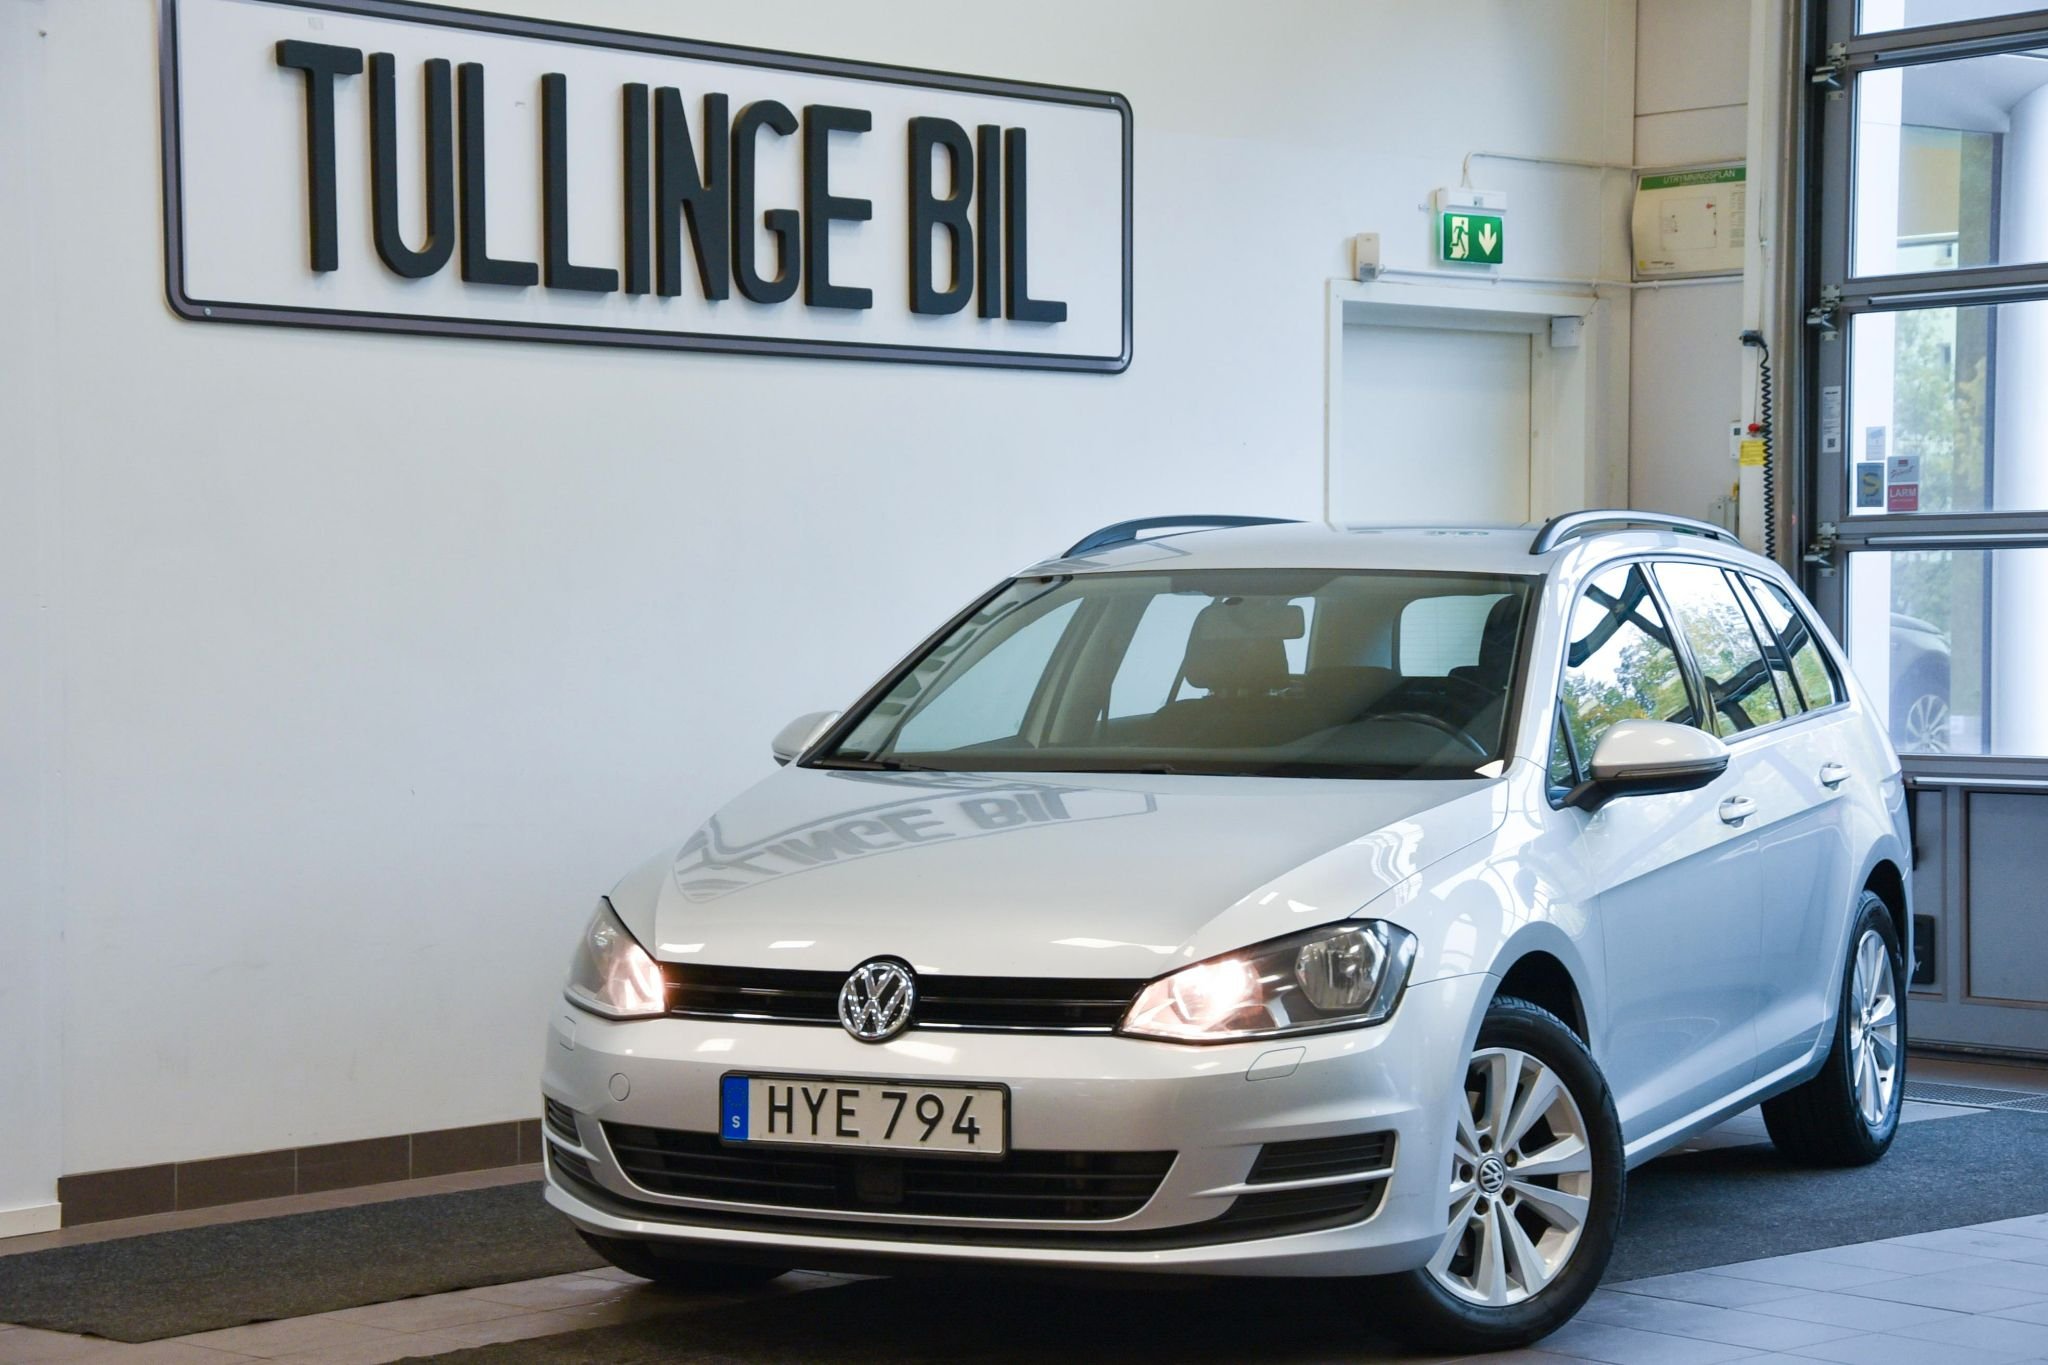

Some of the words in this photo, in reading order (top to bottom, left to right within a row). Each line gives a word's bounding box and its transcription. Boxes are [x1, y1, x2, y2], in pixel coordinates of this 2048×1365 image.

[275, 39, 874, 311] TULLINGE
[909, 116, 1067, 324] BIL
[1663, 169, 1736, 185] UTRYMNINGSPLAN
[1889, 487, 1917, 498] LARM
[840, 962, 914, 1041] VW
[731, 1114, 741, 1129] S
[768, 1085, 860, 1138] HYE
[880, 1090, 981, 1144] 794
